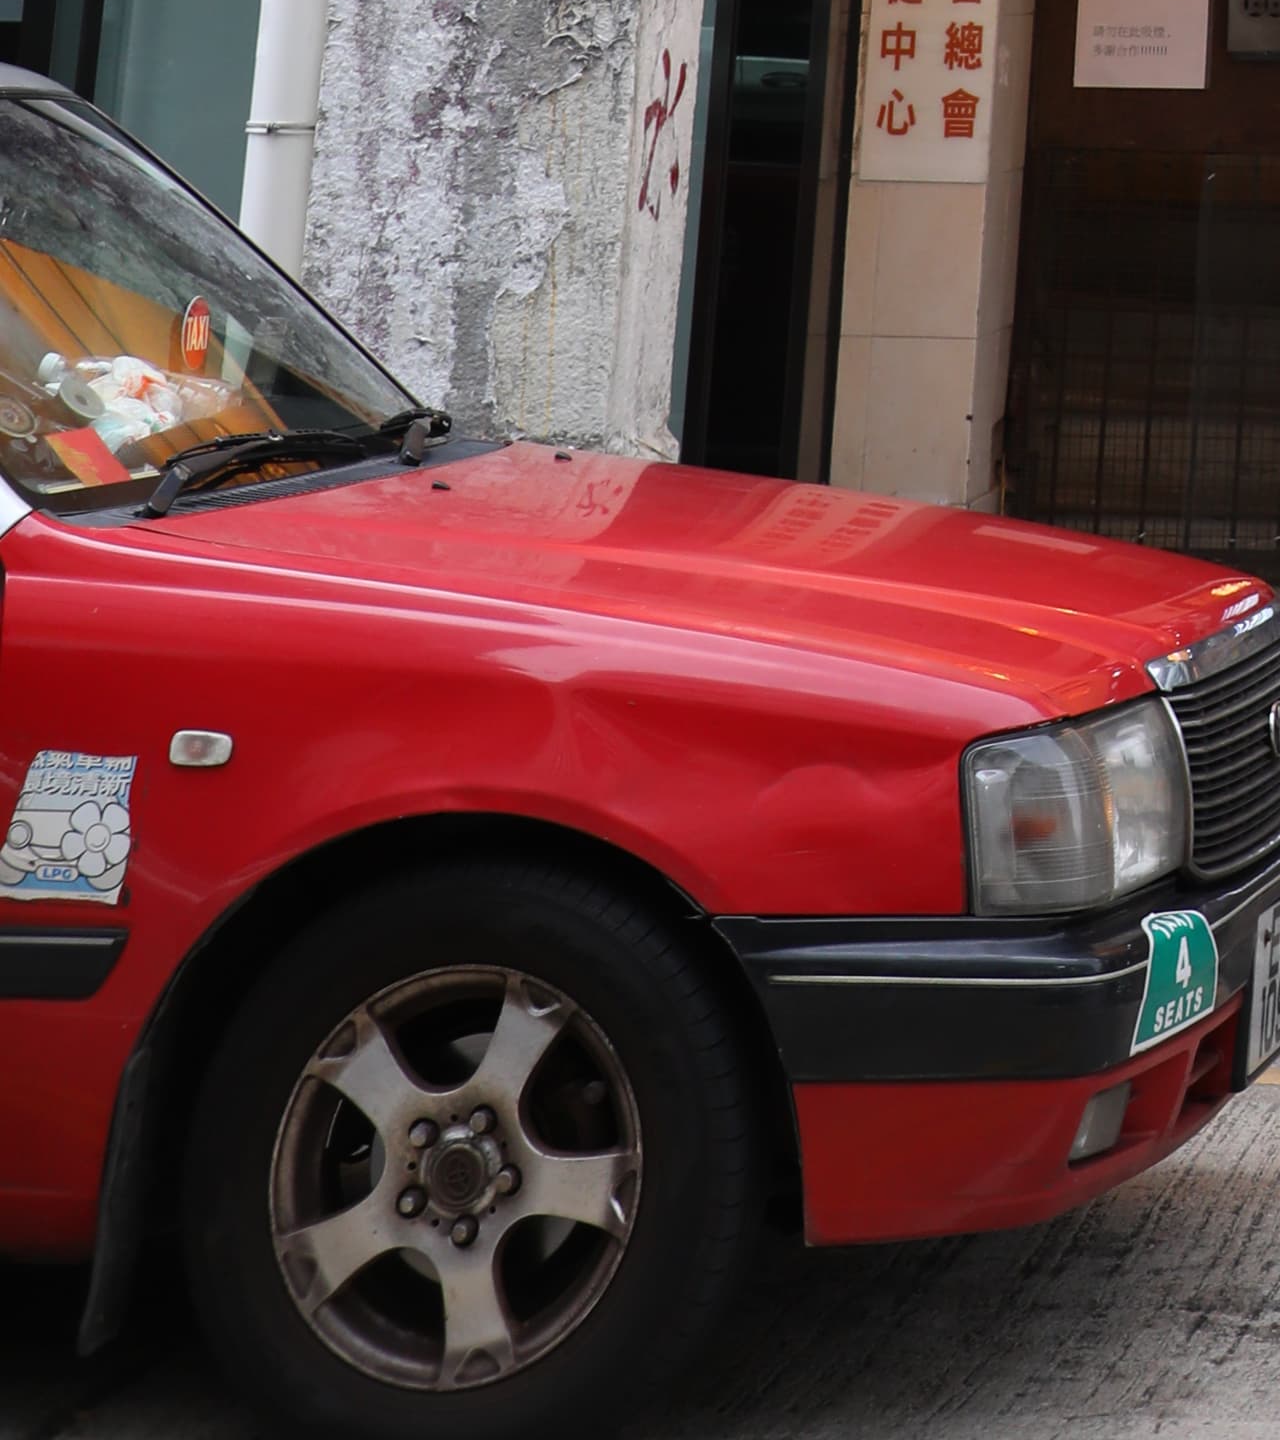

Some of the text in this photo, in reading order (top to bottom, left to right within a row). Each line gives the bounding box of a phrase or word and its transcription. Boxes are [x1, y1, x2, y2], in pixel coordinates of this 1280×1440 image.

[42, 867, 72, 879] LPG
[1176, 936, 1192, 989] 4
[1153, 986, 1203, 1033] SEATS
